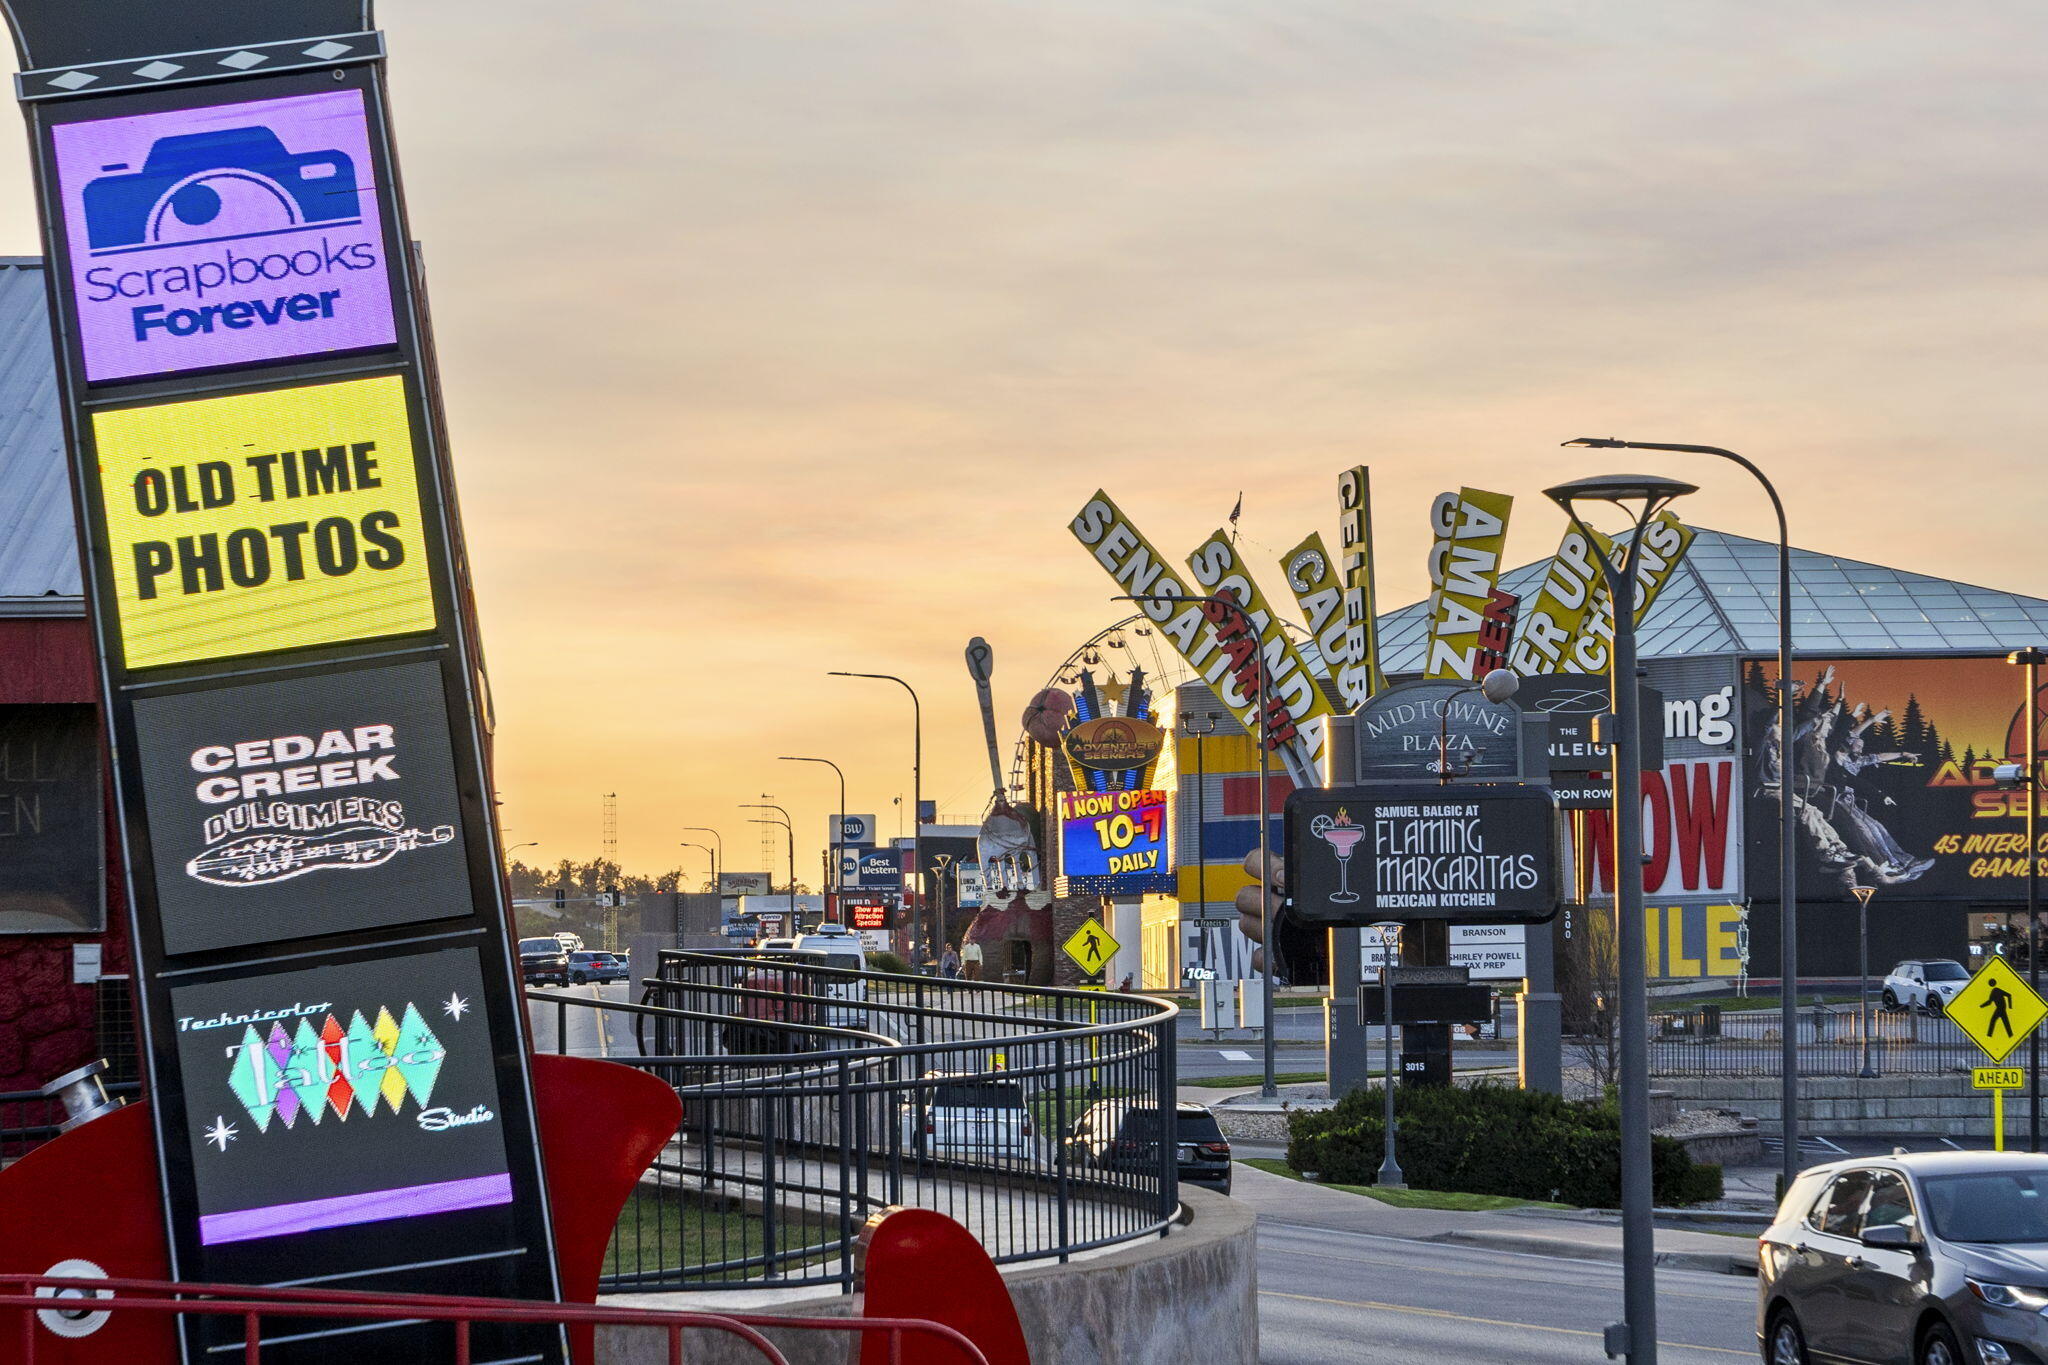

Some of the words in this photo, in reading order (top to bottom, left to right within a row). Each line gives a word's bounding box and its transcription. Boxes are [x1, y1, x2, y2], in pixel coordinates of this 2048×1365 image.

[86, 237, 375, 302] Scrapbooks
[132, 288, 341, 342] Forever
[133, 461, 236, 517] OLD
[247, 441, 382, 503] TIME
[133, 510, 406, 601] PHOTOS
[1367, 700, 1509, 738] MIDTOWNE
[1560, 728, 1578, 736] THE
[190, 724, 396, 773] CEDAR
[1072, 742, 1158, 751] ADVENTURE
[1403, 735, 1474, 751] PLAZA
[1084, 751, 1146, 760] SEEKERS
[196, 754, 401, 804] CREEK
[1583, 789, 1613, 799] ROW
[1074, 795, 1113, 819] NOW
[1375, 806, 1420, 818] SAMUEL
[1423, 805, 1463, 817] BALGIC
[1466, 805, 1479, 816] AT
[203, 797, 405, 845] DULCIMERS
[844, 824, 862, 834] BW
[1095, 807, 1162, 850] 10-7
[1376, 819, 1483, 854] FLAMING
[1933, 835, 1963, 854] 45
[862, 866, 898, 874] Western
[870, 859, 889, 867] Best
[1109, 850, 1158, 875] DAILY
[1376, 854, 1538, 892] MARGARITAS
[1376, 894, 1437, 908] MEXICAN
[1440, 893, 1496, 906] KITCHEN
[1462, 929, 1506, 937] BRANSON
[1450, 953, 1483, 961] SHIRLEY
[1486, 952, 1522, 960] POWELL
[1483, 961, 1506, 969] PREP
[178, 1002, 332, 1032] Technicolor
[1405, 1063, 1425, 1071] 3015
[1978, 1071, 2019, 1084] AHEAD
[417, 1103, 494, 1131] Studio
